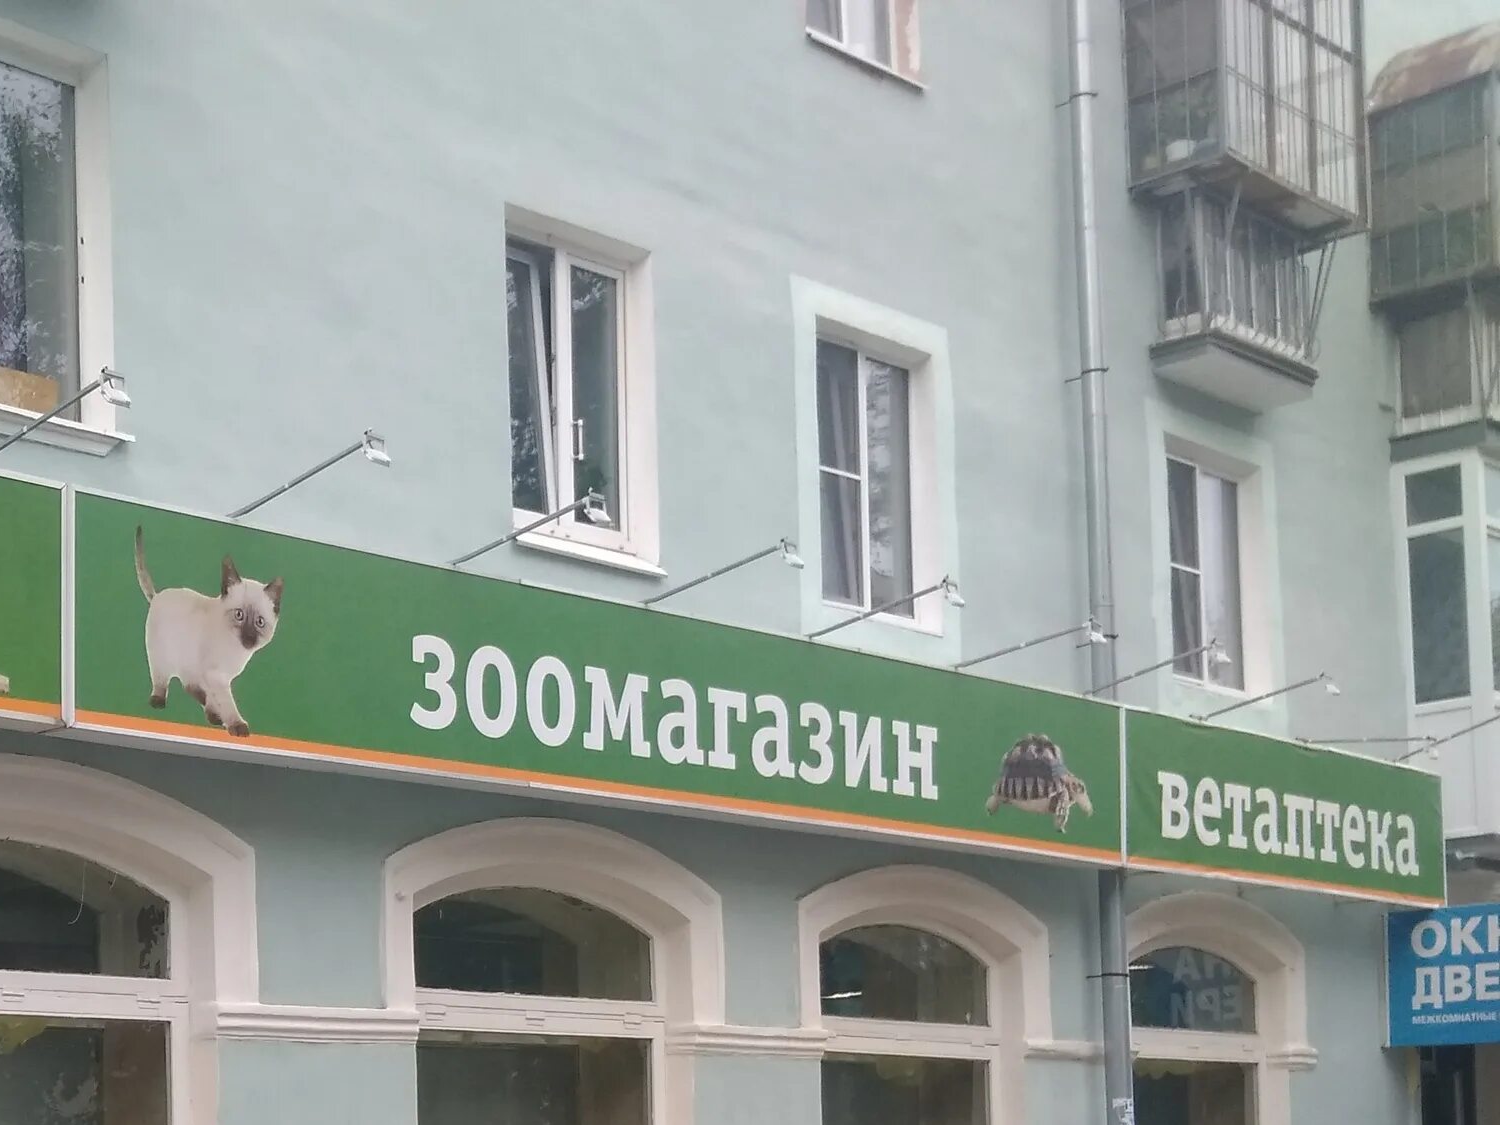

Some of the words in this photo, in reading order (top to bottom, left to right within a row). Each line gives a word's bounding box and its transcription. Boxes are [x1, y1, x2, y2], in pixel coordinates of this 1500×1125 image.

[411, 635, 938, 800] зоомагазин
[1157, 771, 1420, 877] ветаптека
[1411, 1011, 1497, 1024] МЕЖКОМНАТНЫЕ
